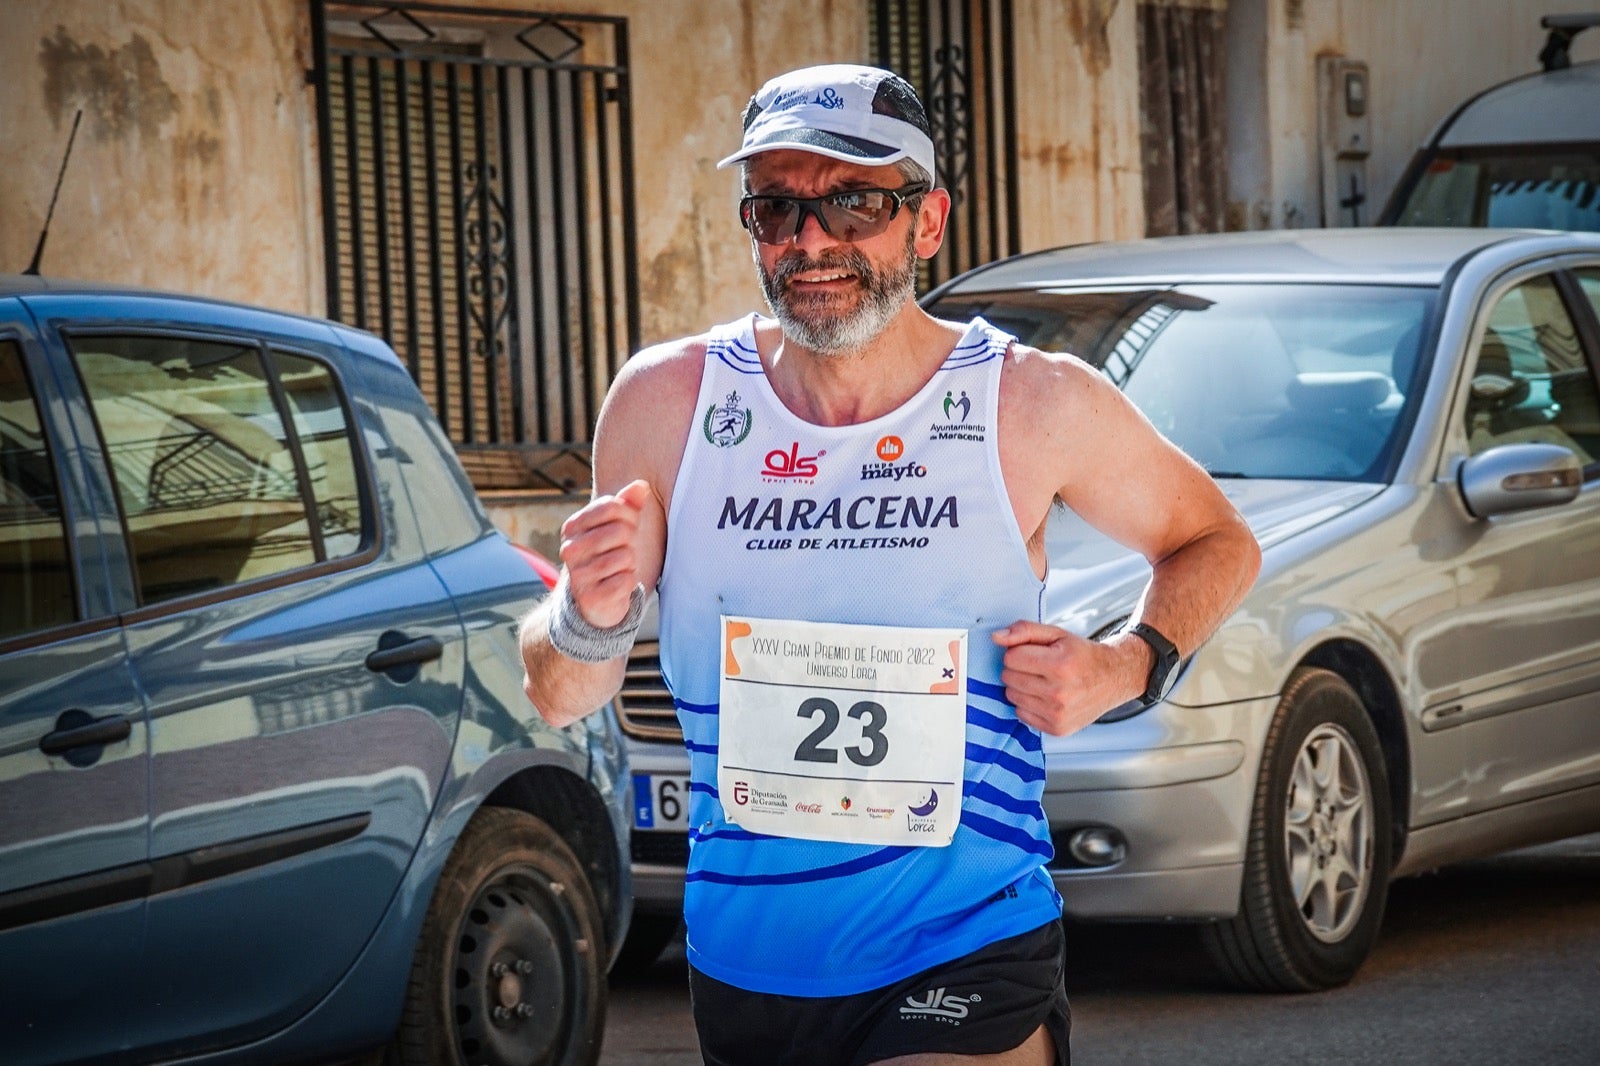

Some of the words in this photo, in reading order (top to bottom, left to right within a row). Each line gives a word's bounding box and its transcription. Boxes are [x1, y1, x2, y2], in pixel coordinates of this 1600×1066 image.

[930, 423, 986, 432] Ayuntamiento
[938, 432, 985, 442] Maracena
[860, 461, 927, 481] mayfo
[717, 496, 959, 531] MARACENA
[746, 538, 792, 550] CLUB
[798, 538, 822, 549] DE
[826, 537, 930, 550] ATLETISMO
[752, 637, 780, 656] XXXV
[907, 647, 935, 665] 2022
[794, 697, 889, 767] 23
